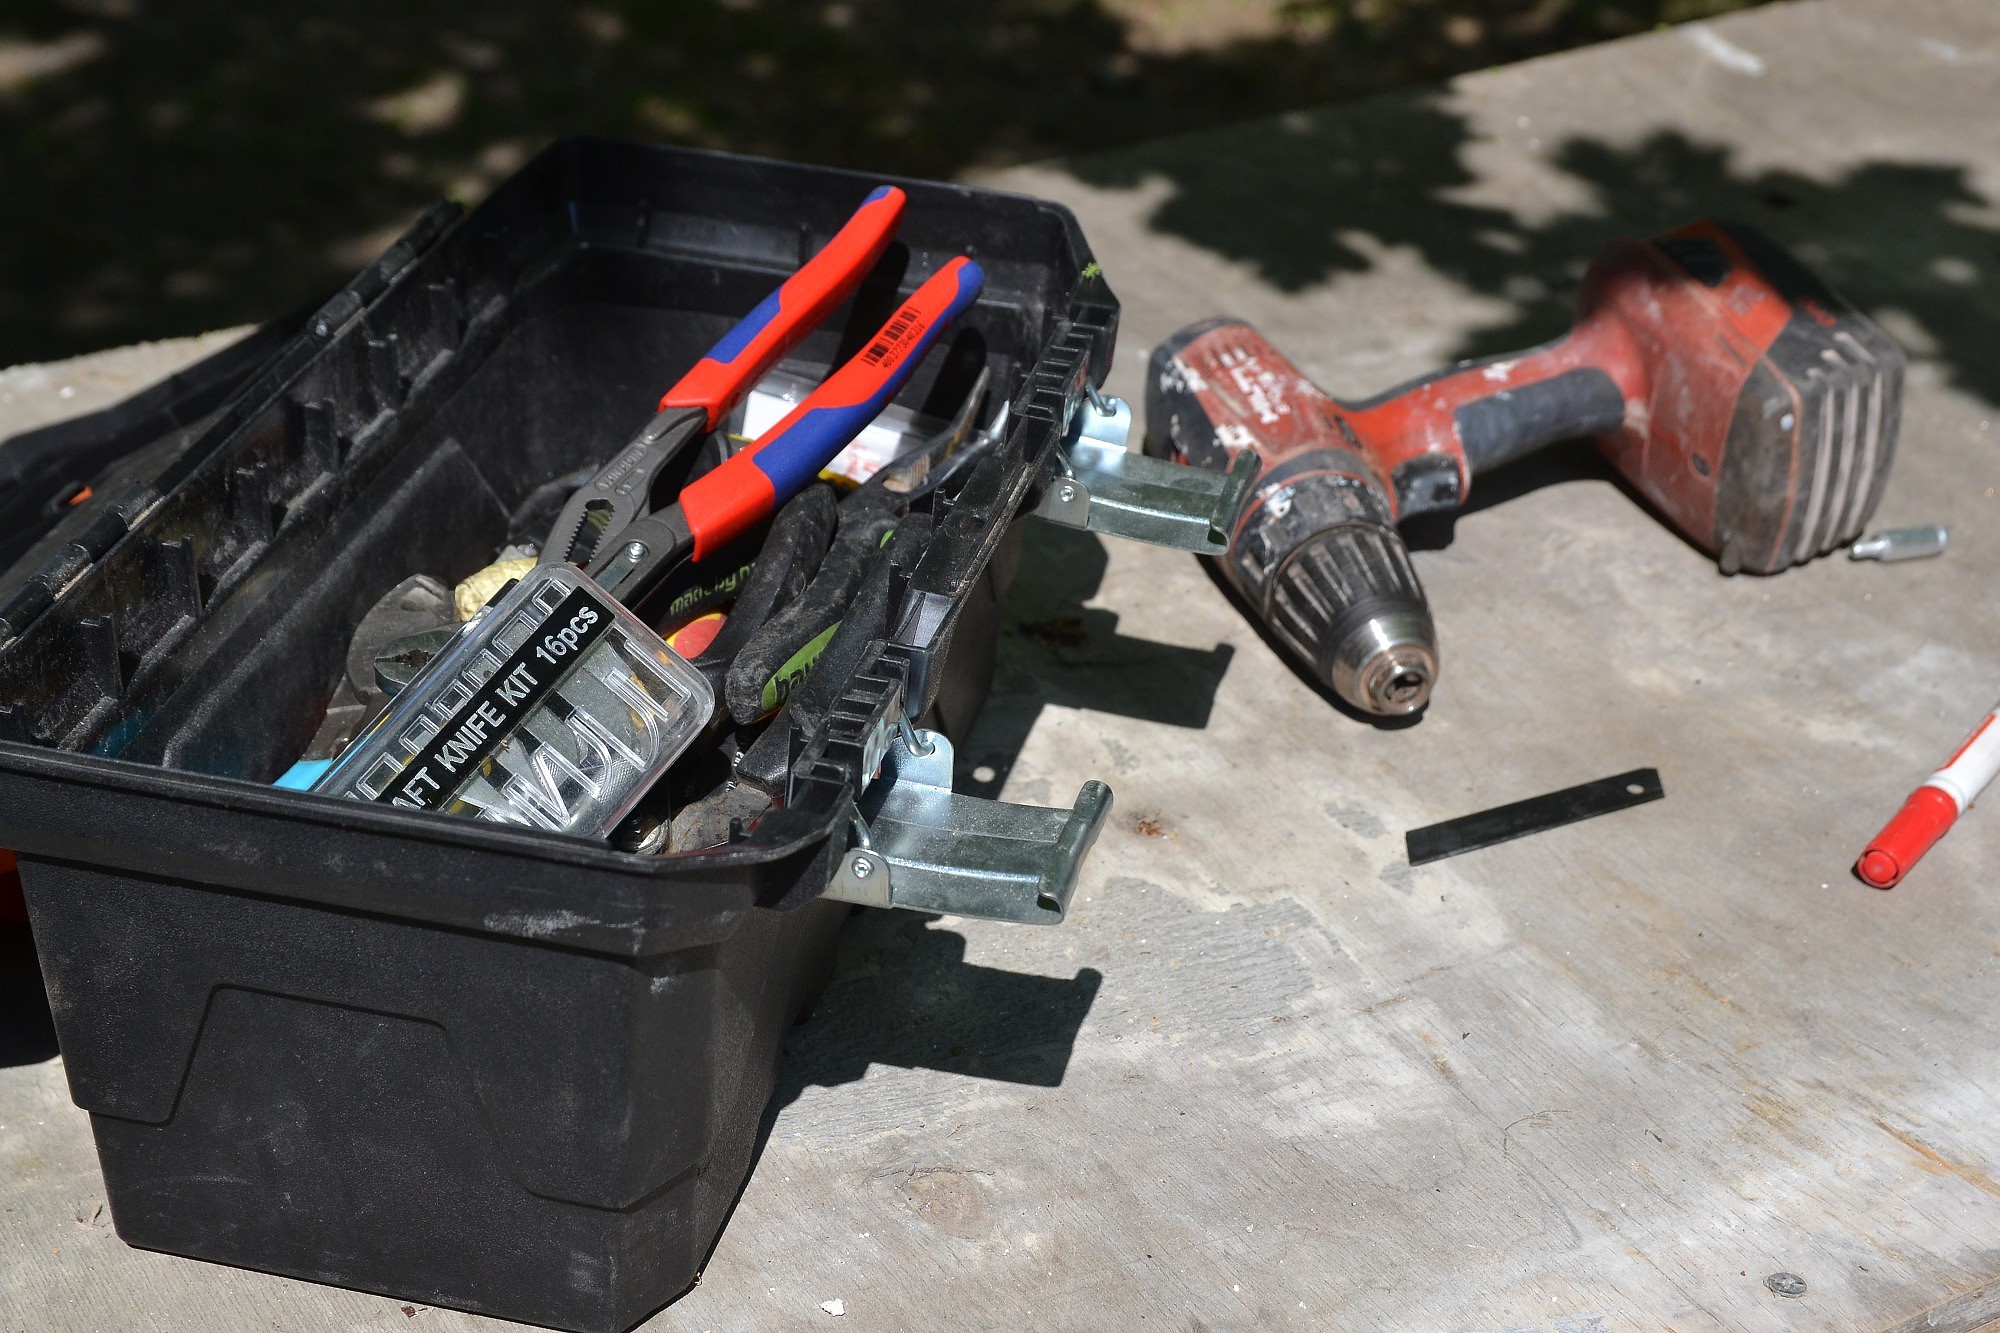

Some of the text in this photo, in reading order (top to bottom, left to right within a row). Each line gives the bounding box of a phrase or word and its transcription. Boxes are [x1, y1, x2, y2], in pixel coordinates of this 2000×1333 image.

[434, 701, 507, 772] KNIFE
[495, 662, 538, 706] KIT
[536, 606, 599, 664] 16pcs
